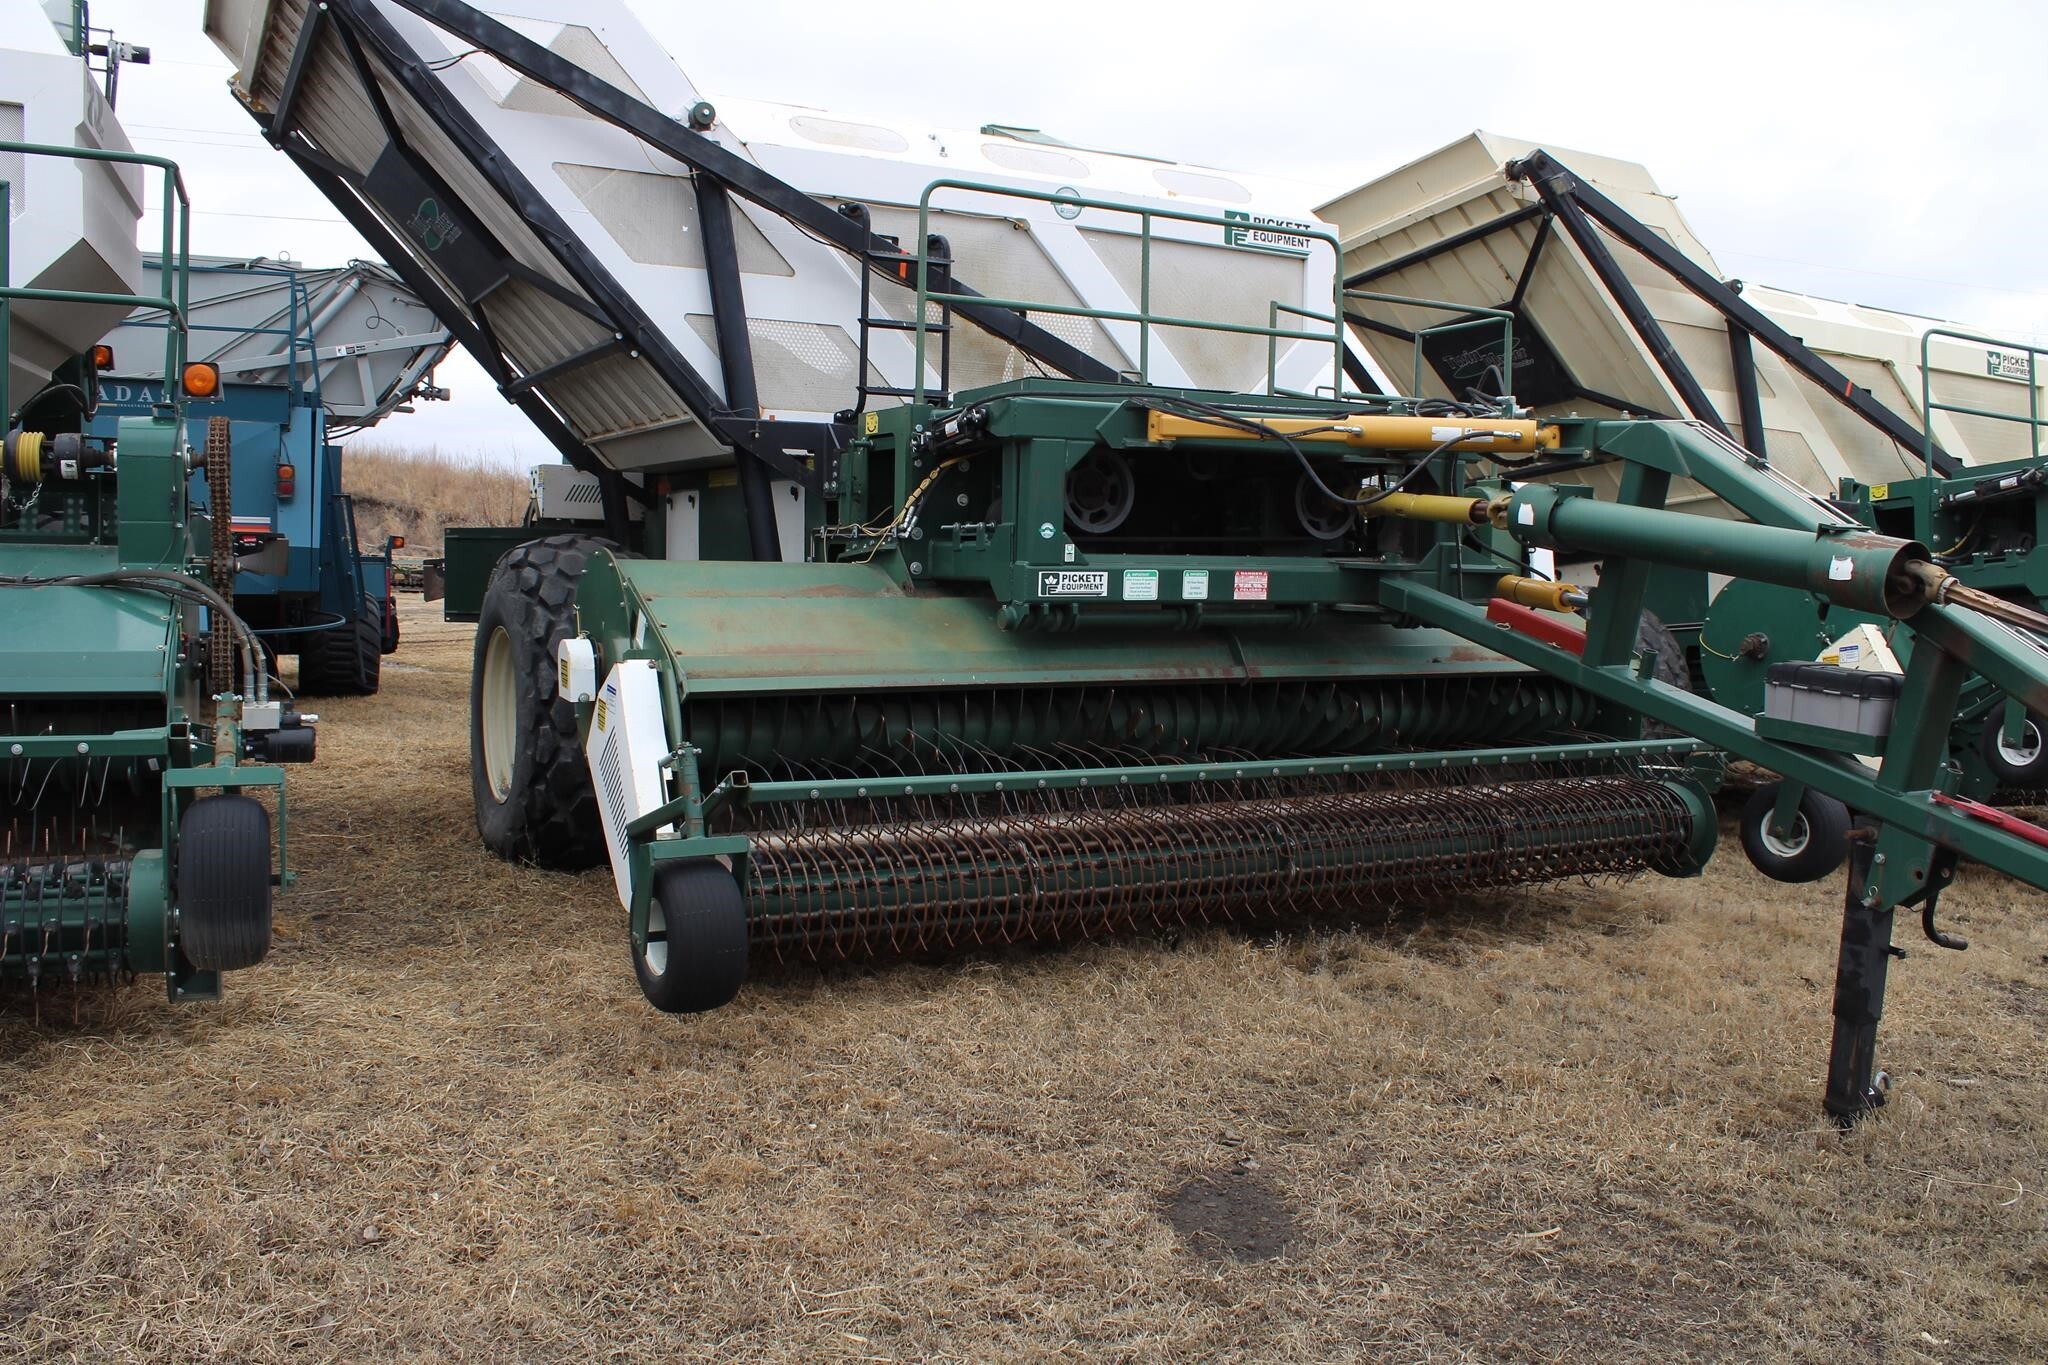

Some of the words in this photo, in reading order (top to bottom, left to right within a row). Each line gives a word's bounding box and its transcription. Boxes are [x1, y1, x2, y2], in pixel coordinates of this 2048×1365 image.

[1253, 231, 1311, 249] EQUIPMENT
[1061, 574, 1104, 583] PICKETT
[1061, 583, 1104, 591] EQUIPMENT
